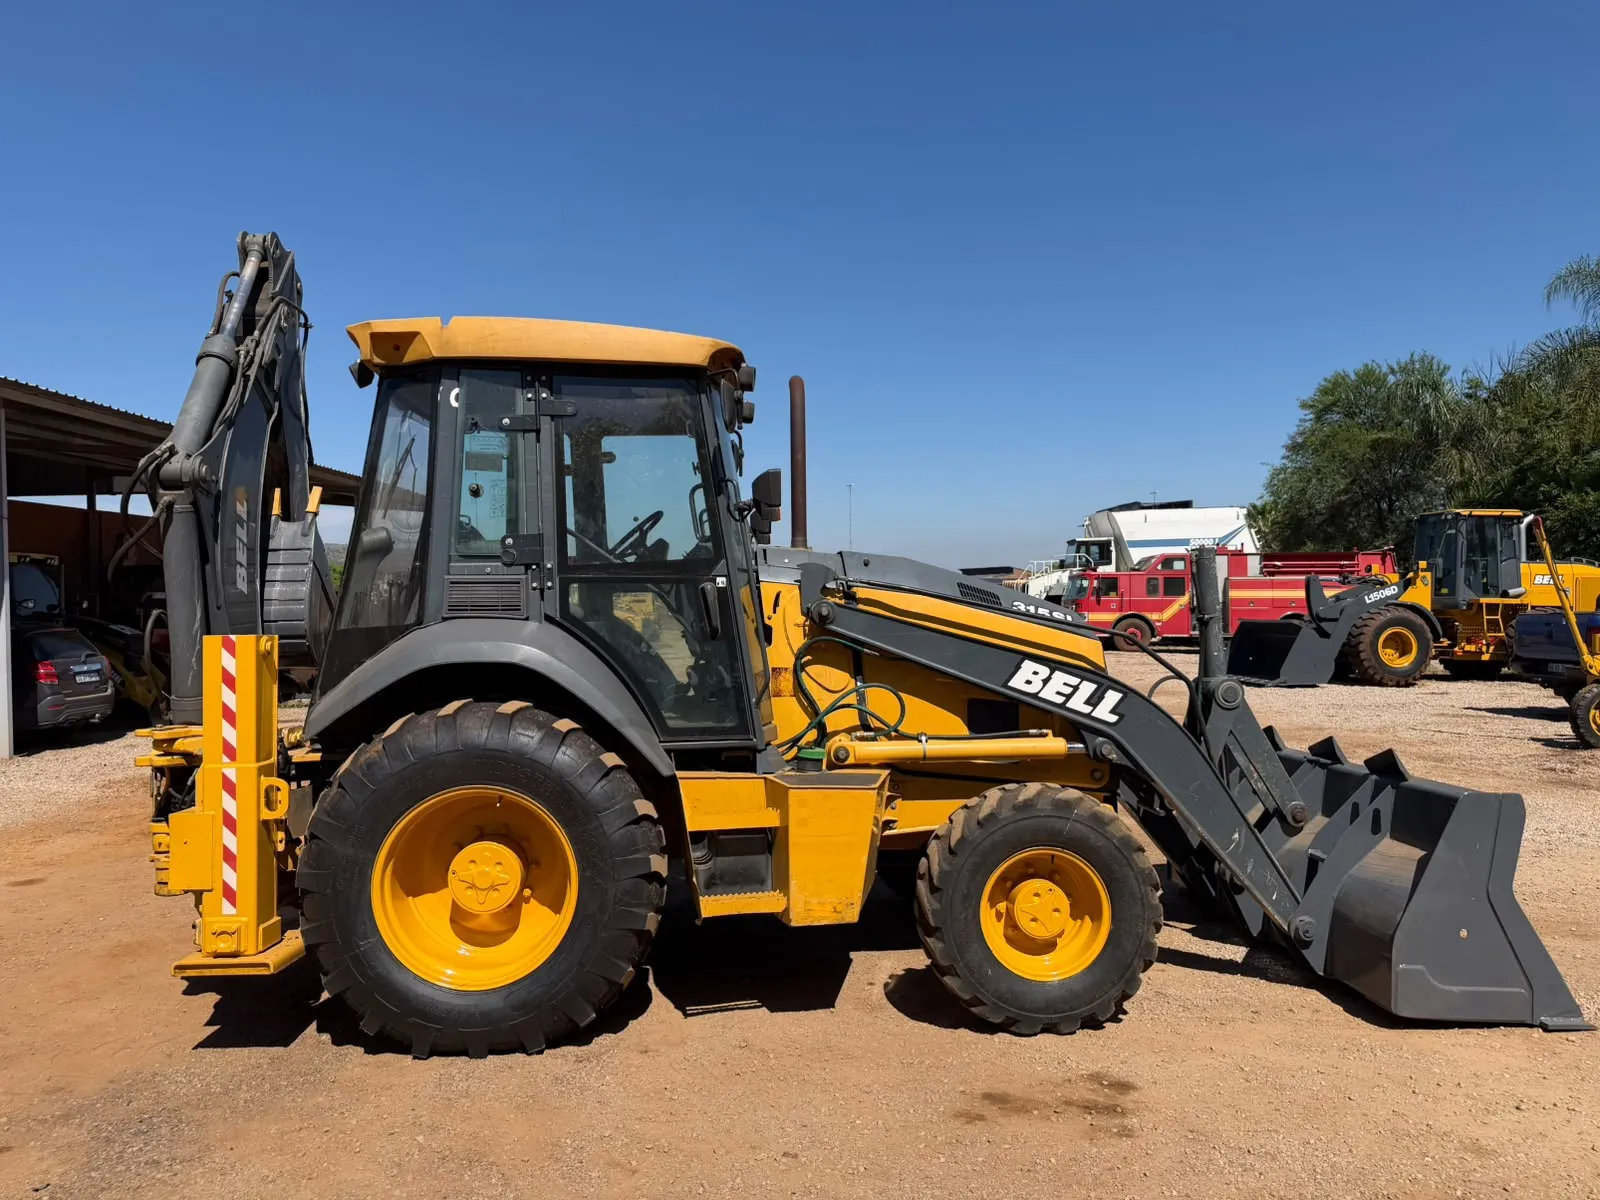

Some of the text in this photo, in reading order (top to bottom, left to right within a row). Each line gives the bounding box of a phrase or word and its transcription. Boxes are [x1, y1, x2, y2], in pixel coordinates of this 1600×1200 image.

[235, 499, 247, 595] BELL
[1364, 585, 1398, 604] L1506D
[1534, 575, 1564, 584] BE
[1007, 659, 1123, 723] BELL
